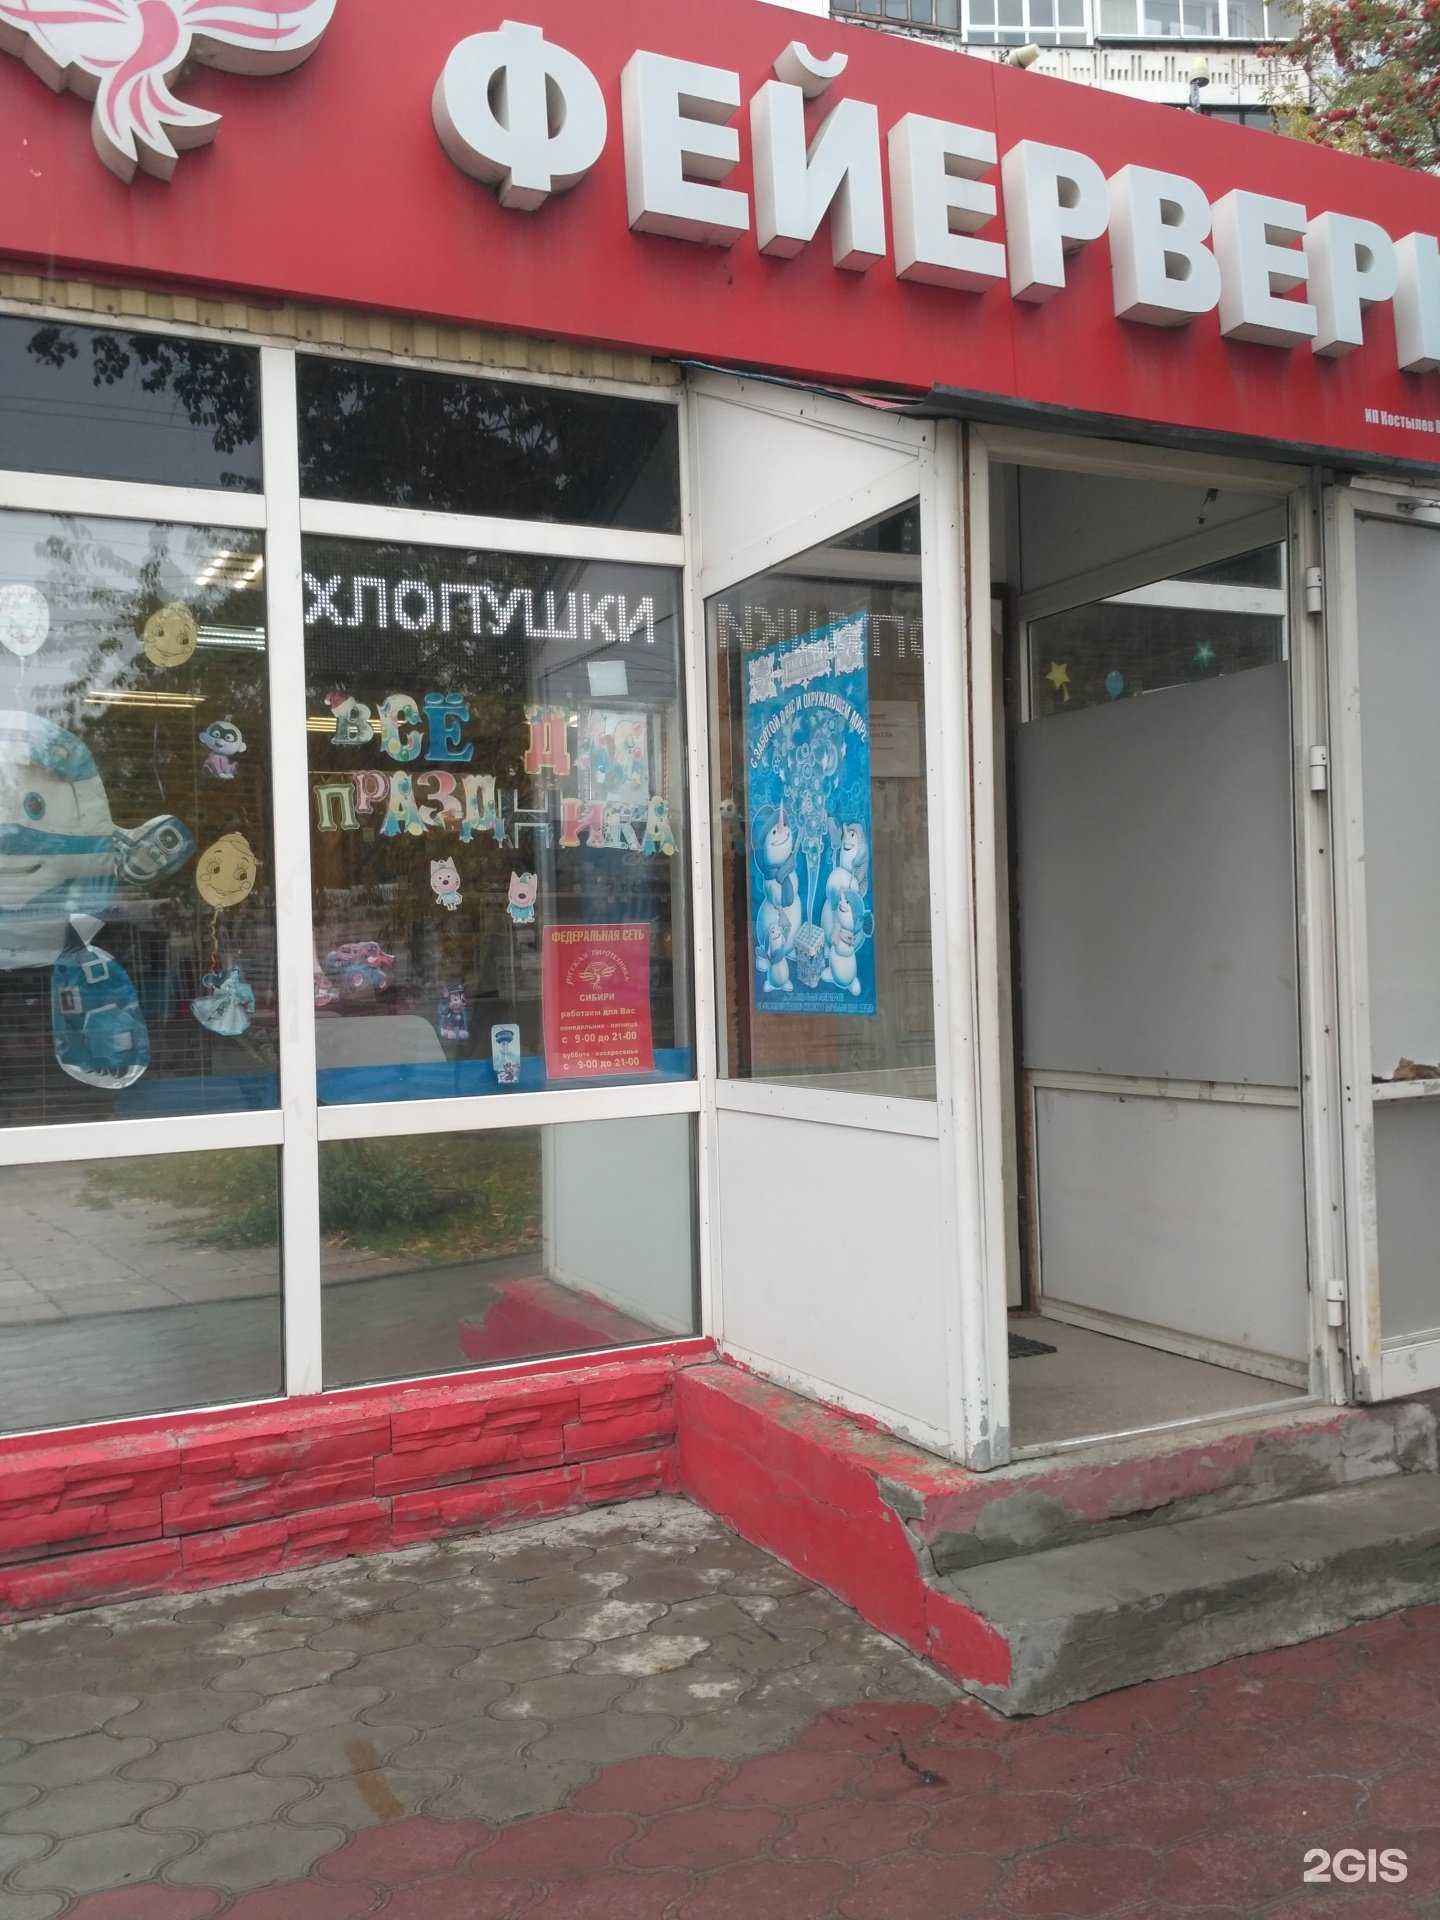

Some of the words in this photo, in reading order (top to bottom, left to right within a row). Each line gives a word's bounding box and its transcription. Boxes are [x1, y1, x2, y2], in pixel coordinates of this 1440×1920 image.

[1364, 407, 1379, 424] ИП
[303, 572, 656, 644] ХЛОПУШКИ
[324, 690, 474, 762] ВСЁ
[313, 769, 680, 856] ПРАЗДНИКА
[551, 929, 621, 944] ФЕДЕРАЛЬНАЯ
[622, 928, 646, 941] СЕТЬ
